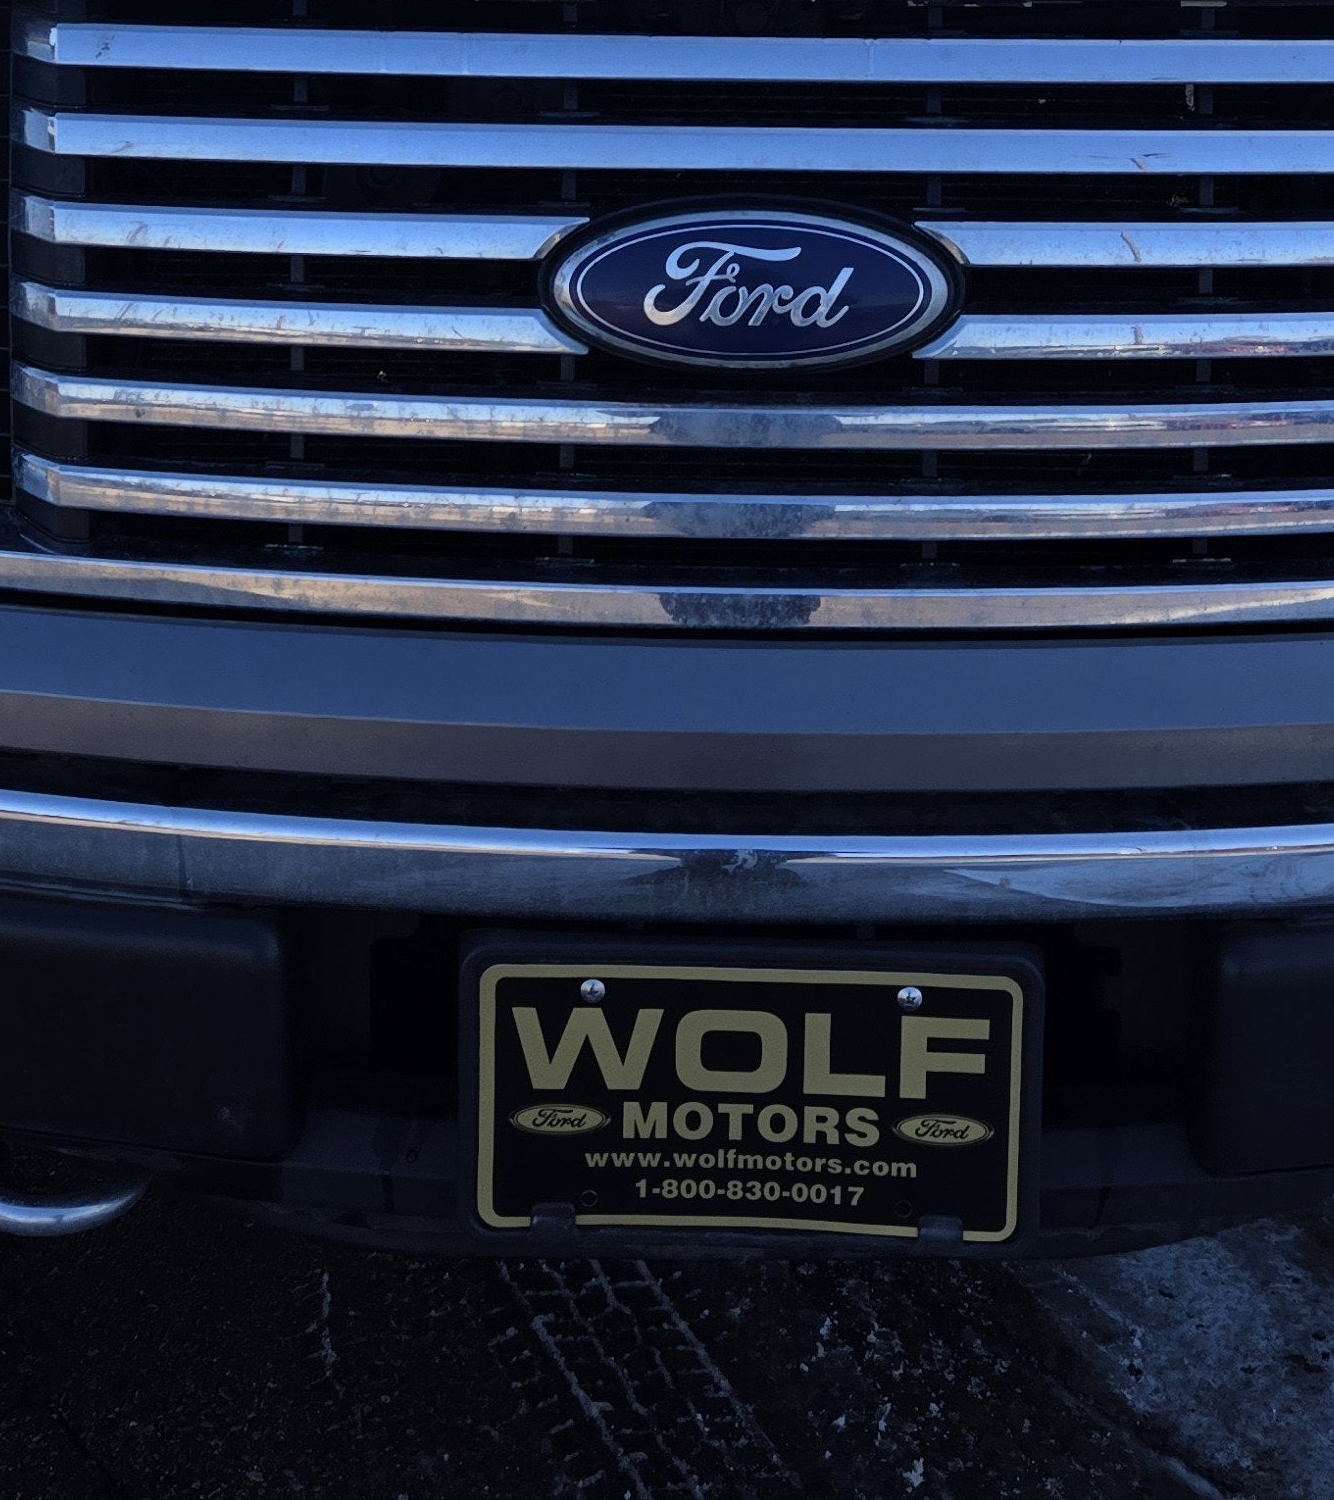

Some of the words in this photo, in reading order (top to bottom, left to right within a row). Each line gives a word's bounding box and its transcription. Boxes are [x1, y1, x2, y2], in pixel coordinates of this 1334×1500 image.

[643, 240, 855, 328] Ford
[511, 1006, 990, 1100] WOLF
[532, 1108, 588, 1128] Ford
[622, 1101, 880, 1147] MOTORS
[914, 1118, 970, 1140] Ford
[584, 1148, 917, 1178] www.wolfmotors.com
[635, 1178, 865, 1207] 1-800-830-0017
